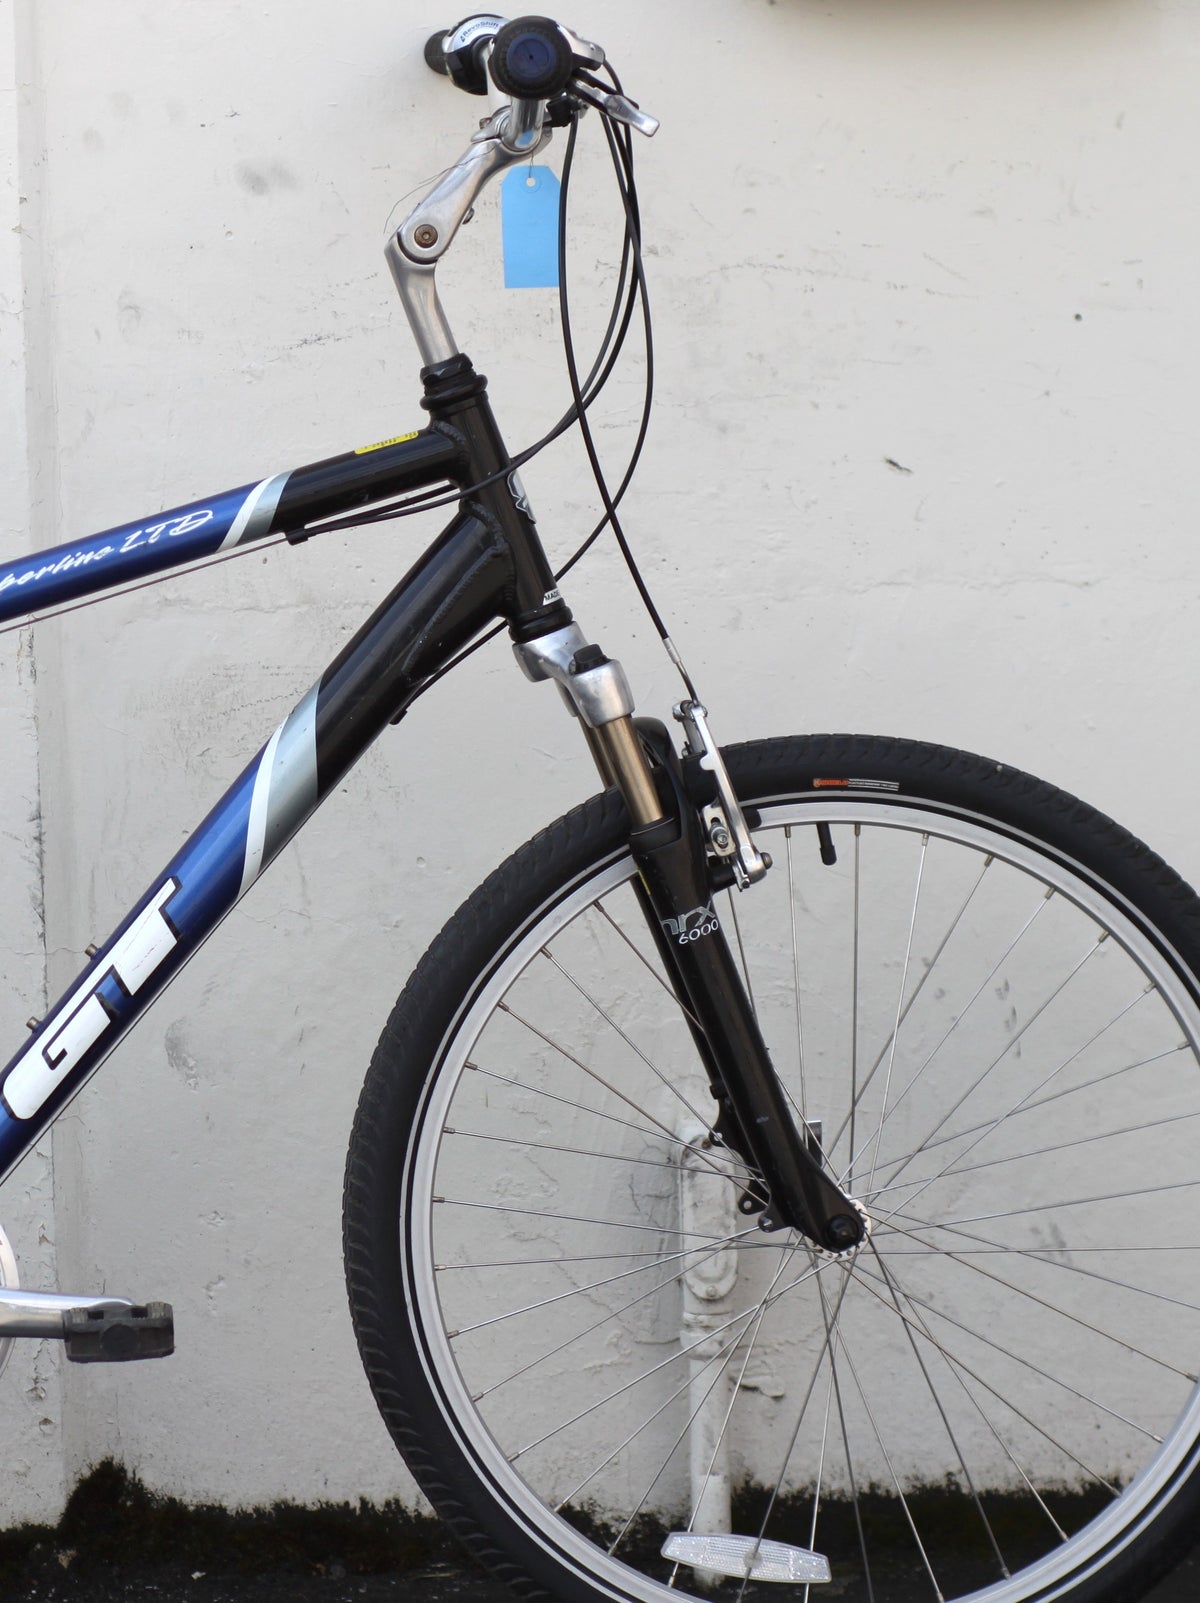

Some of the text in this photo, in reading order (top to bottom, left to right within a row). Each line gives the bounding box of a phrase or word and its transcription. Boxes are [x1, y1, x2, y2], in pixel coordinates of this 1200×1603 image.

[119, 509, 214, 554] LTD
[678, 918, 719, 945] 6000
[0, 876, 180, 1121] GT
